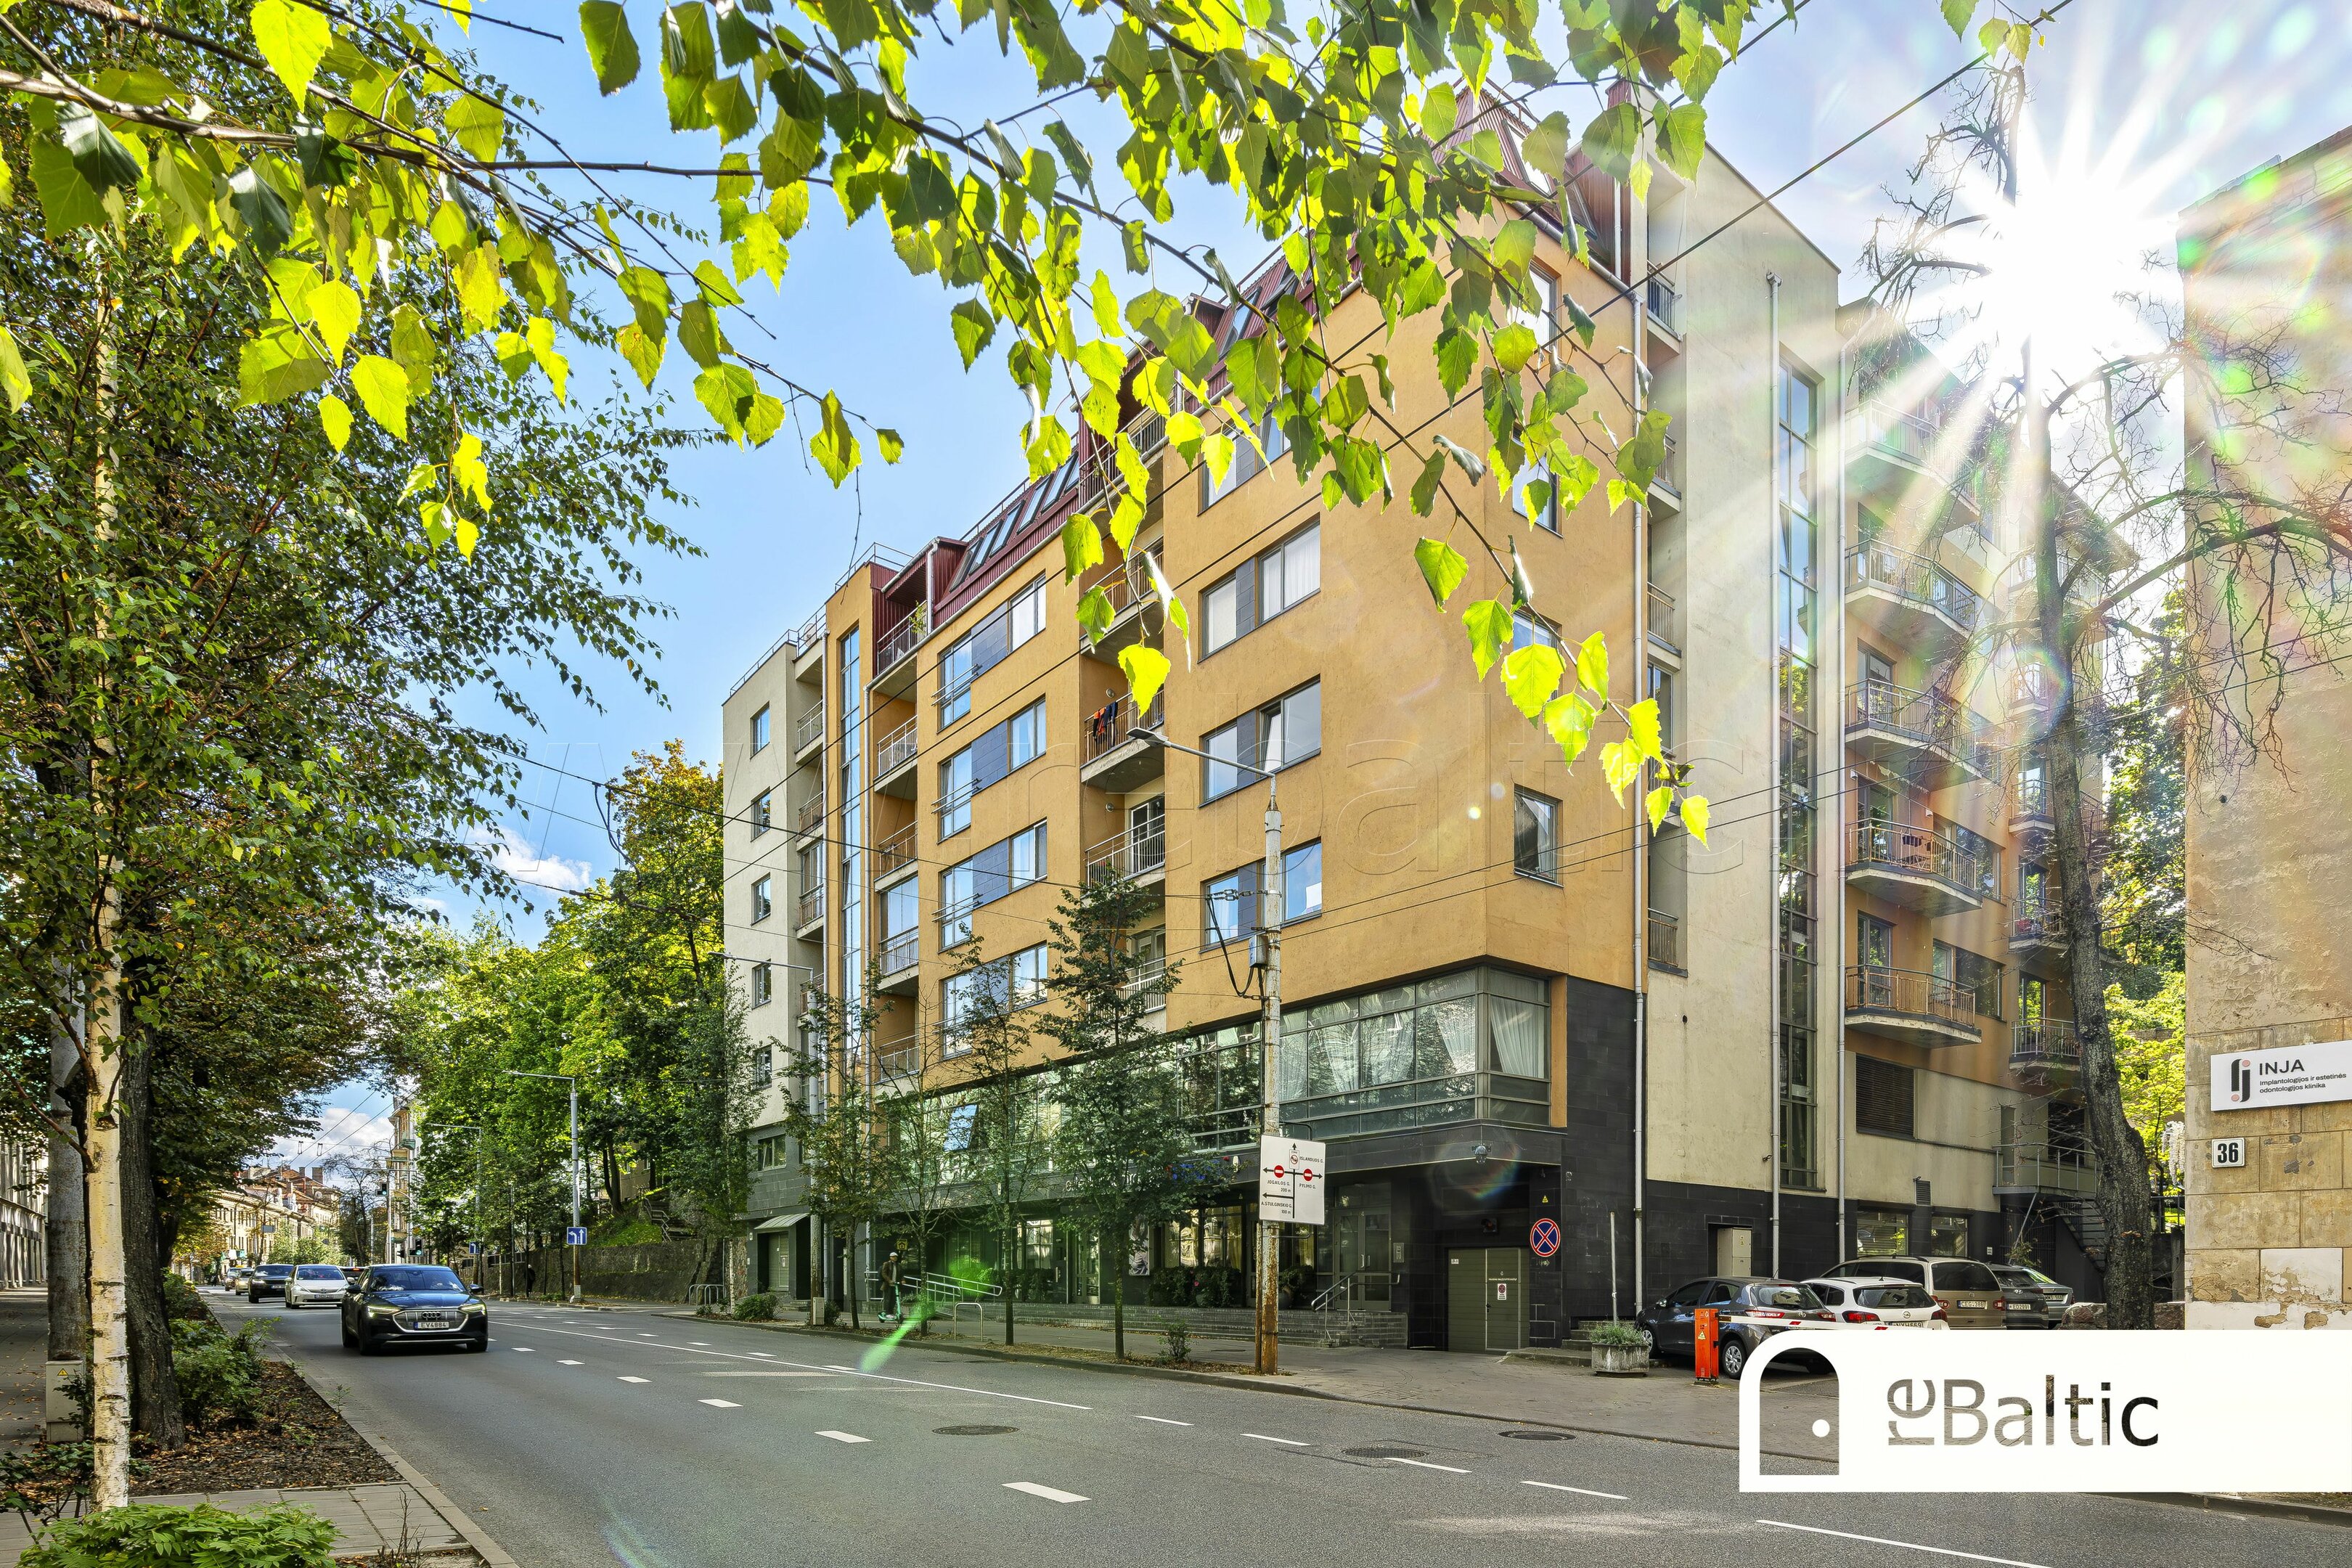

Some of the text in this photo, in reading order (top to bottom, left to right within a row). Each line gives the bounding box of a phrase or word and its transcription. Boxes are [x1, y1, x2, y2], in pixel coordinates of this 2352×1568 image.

[2259, 1059, 2305, 1075] INJA
[2260, 1077, 2309, 1086] Implantologijos
[2259, 1085, 2303, 1093] odontologijos
[2217, 1142, 2239, 1163] 36
